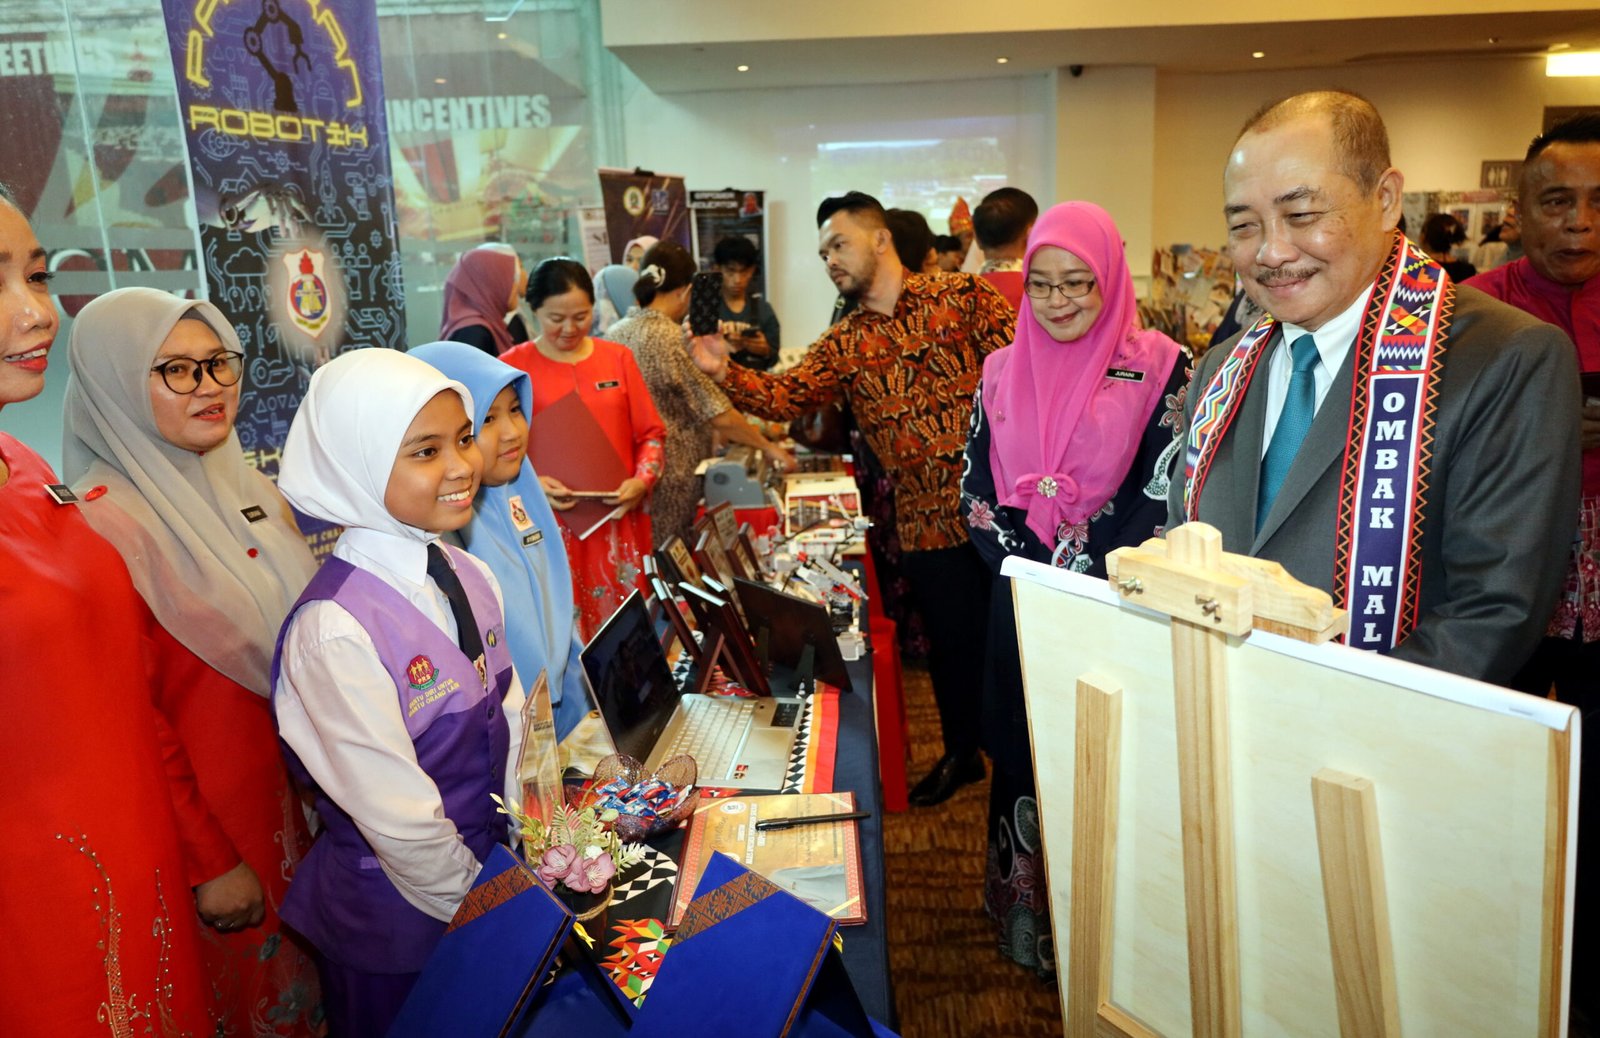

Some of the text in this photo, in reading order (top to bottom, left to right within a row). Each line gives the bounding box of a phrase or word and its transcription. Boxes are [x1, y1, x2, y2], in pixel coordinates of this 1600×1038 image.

[189, 105, 368, 148] ROBOTIK
[385, 94, 552, 132] INCENTIVES
[1368, 391, 1406, 529] OMBAK
[1361, 565, 1393, 654] MAL
[417, 674, 431, 685] PRS
